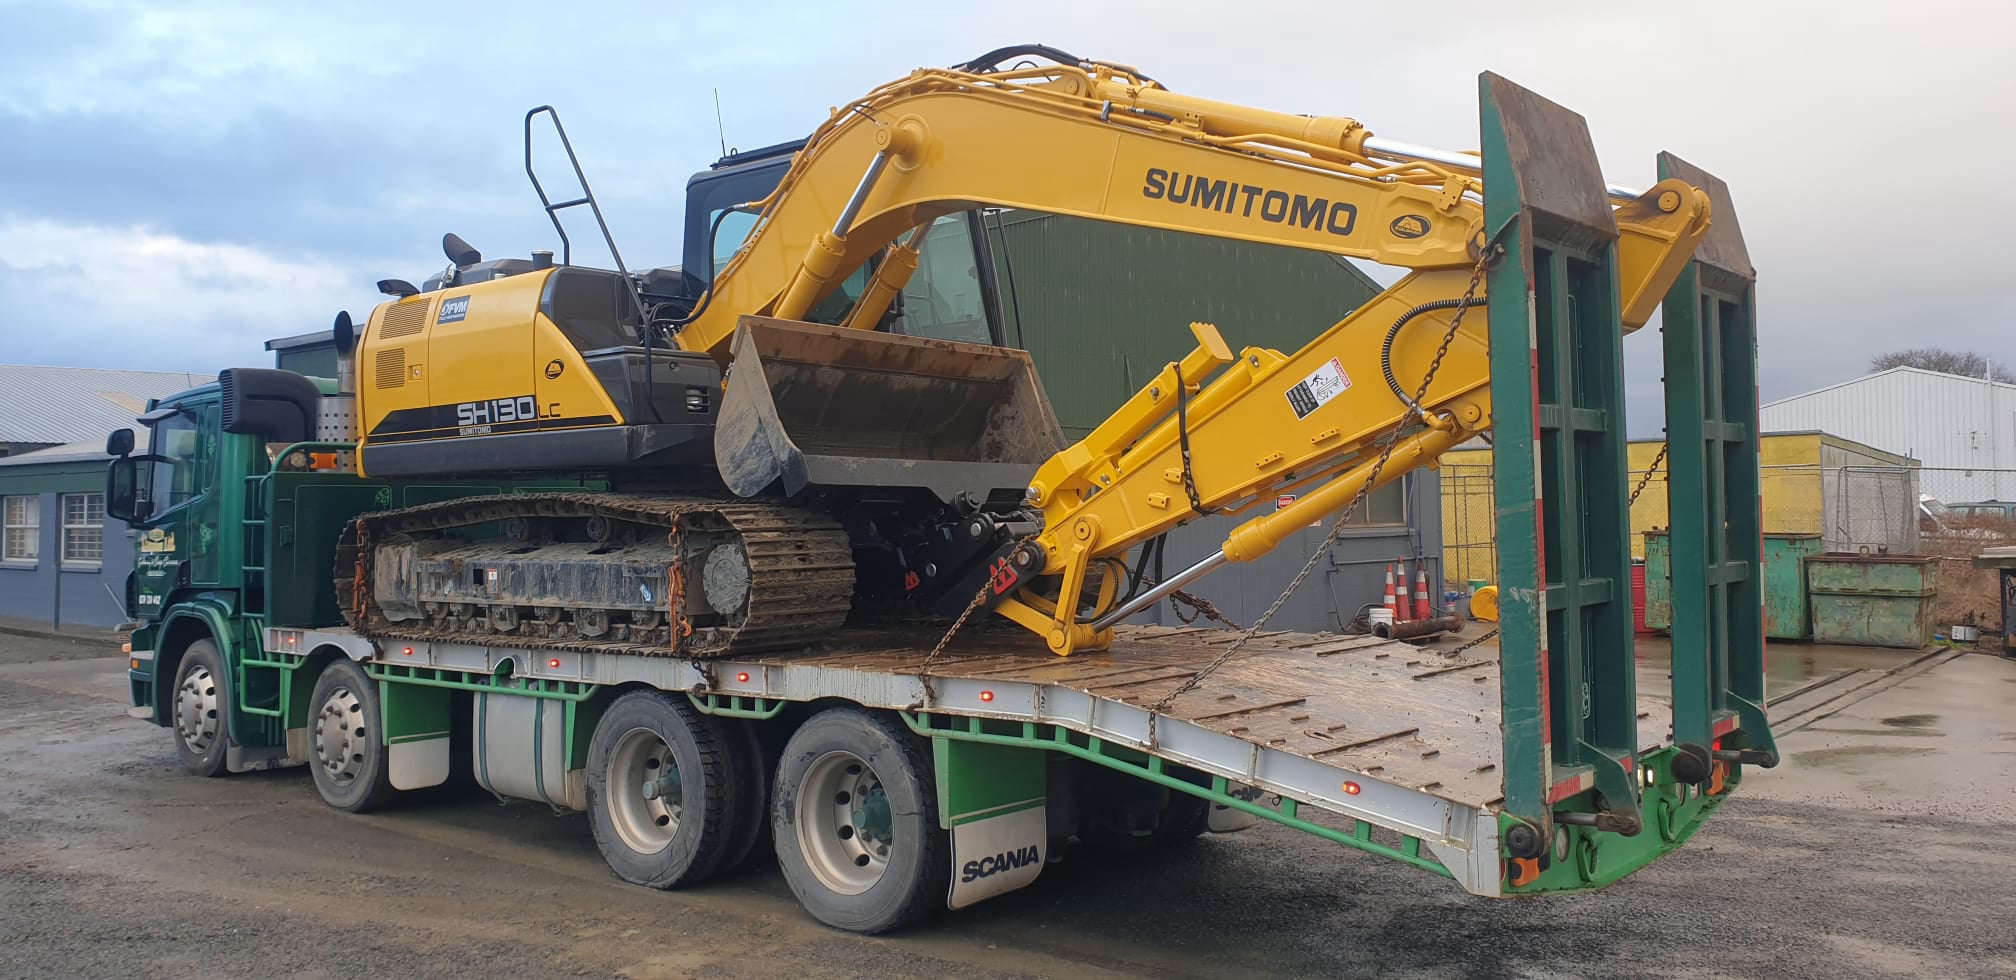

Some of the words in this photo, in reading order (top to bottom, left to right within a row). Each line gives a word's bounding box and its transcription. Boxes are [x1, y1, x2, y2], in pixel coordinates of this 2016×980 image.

[1143, 168, 1357, 236] SUMITOMO
[457, 397, 535, 426] SH130
[538, 403, 561, 418] LC
[459, 426, 492, 436] SUMITOMO
[962, 845, 1039, 883] SCANIA
